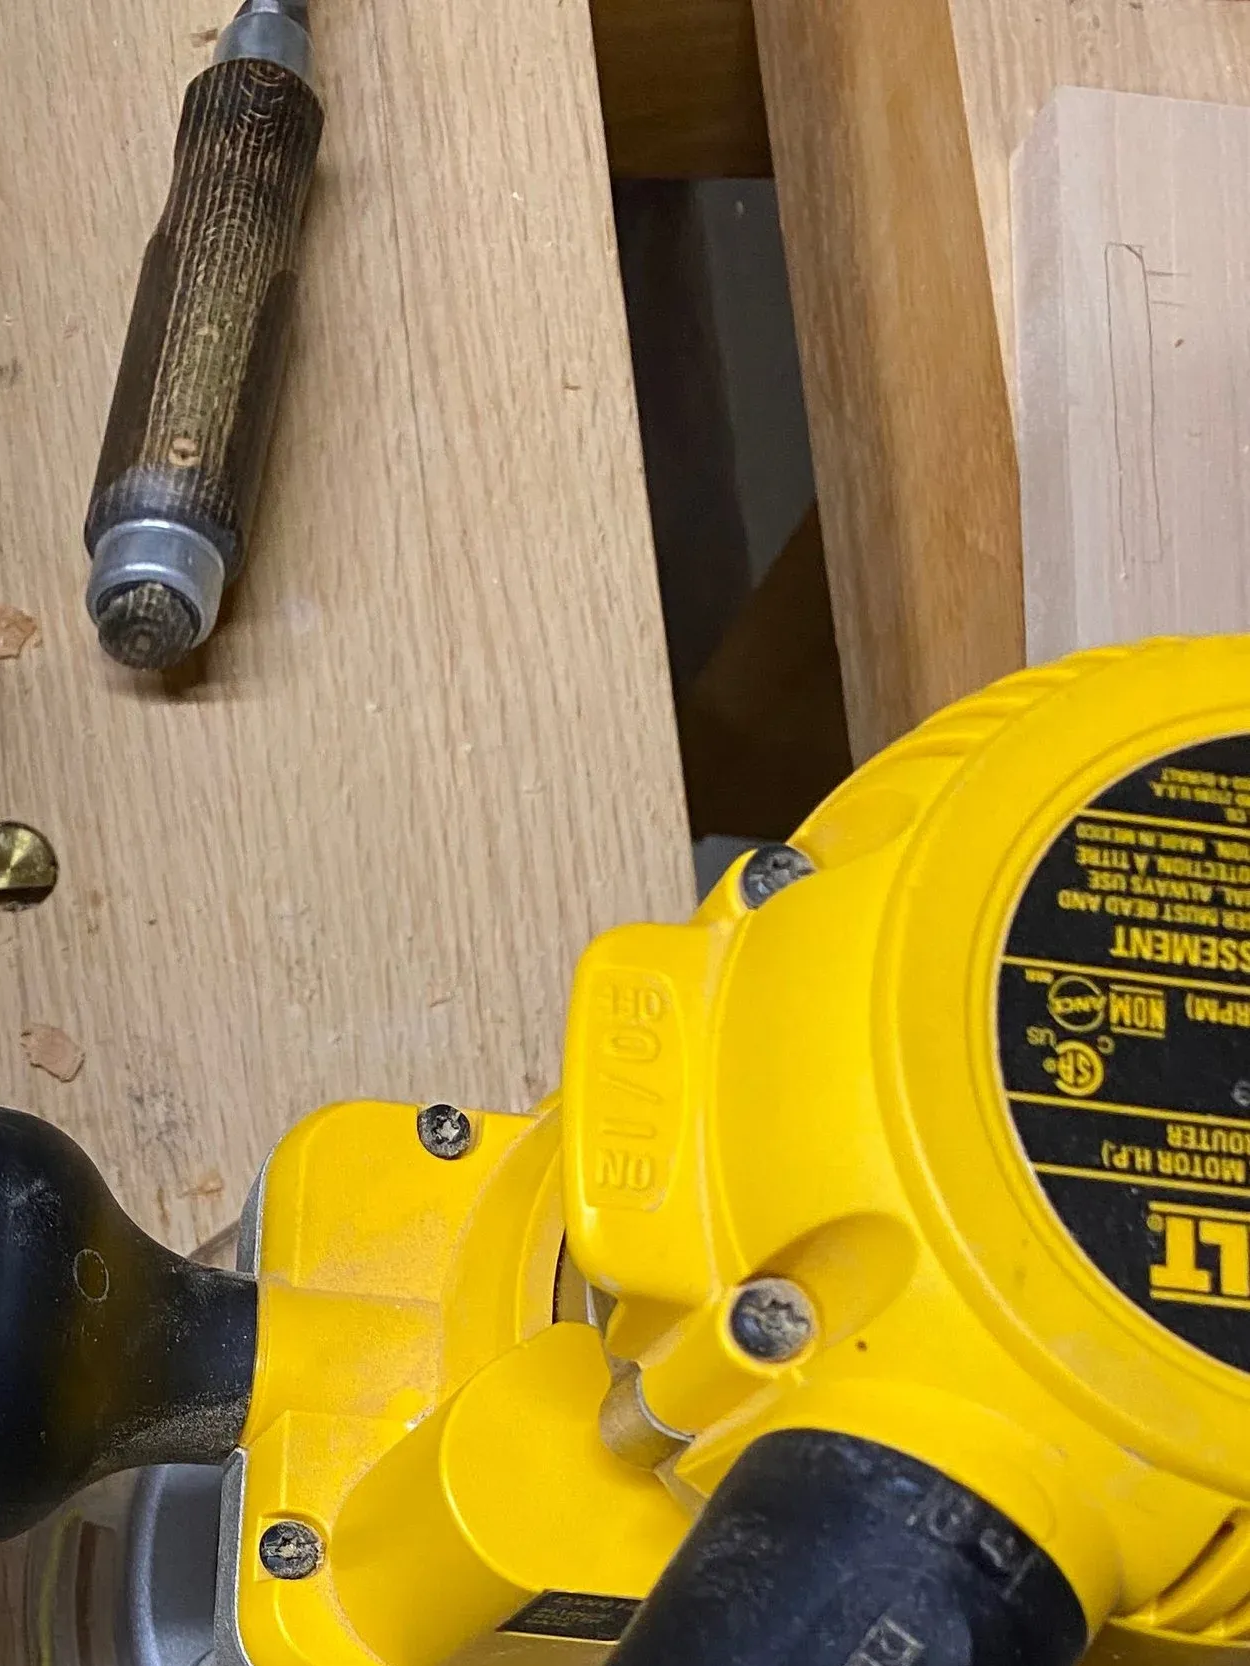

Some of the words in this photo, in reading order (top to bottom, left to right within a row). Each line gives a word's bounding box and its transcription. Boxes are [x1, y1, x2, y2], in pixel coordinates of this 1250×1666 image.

[1057, 889, 1101, 913] AND
[1109, 991, 1166, 1032] NOM
[595, 1149, 655, 1190] ON
[1157, 1150, 1246, 1183] MOTOR
